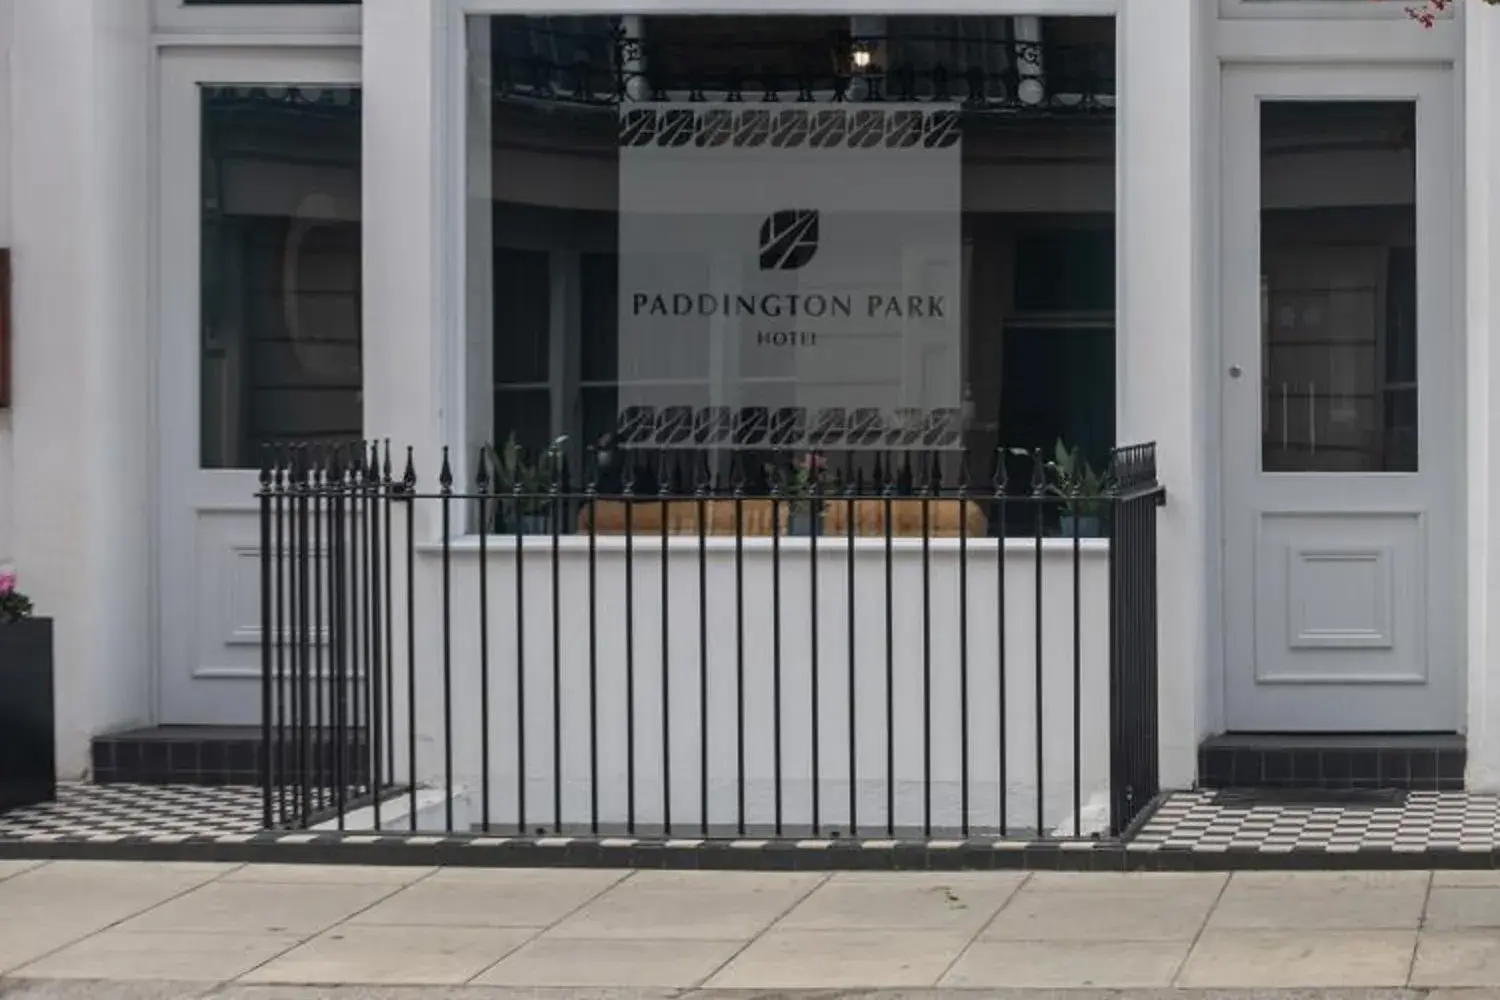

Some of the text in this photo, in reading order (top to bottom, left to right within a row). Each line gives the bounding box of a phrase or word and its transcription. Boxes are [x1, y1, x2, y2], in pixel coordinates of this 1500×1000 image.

[632, 292, 946, 318] PADDINGTON PARK
[756, 330, 817, 347] HOTEL
